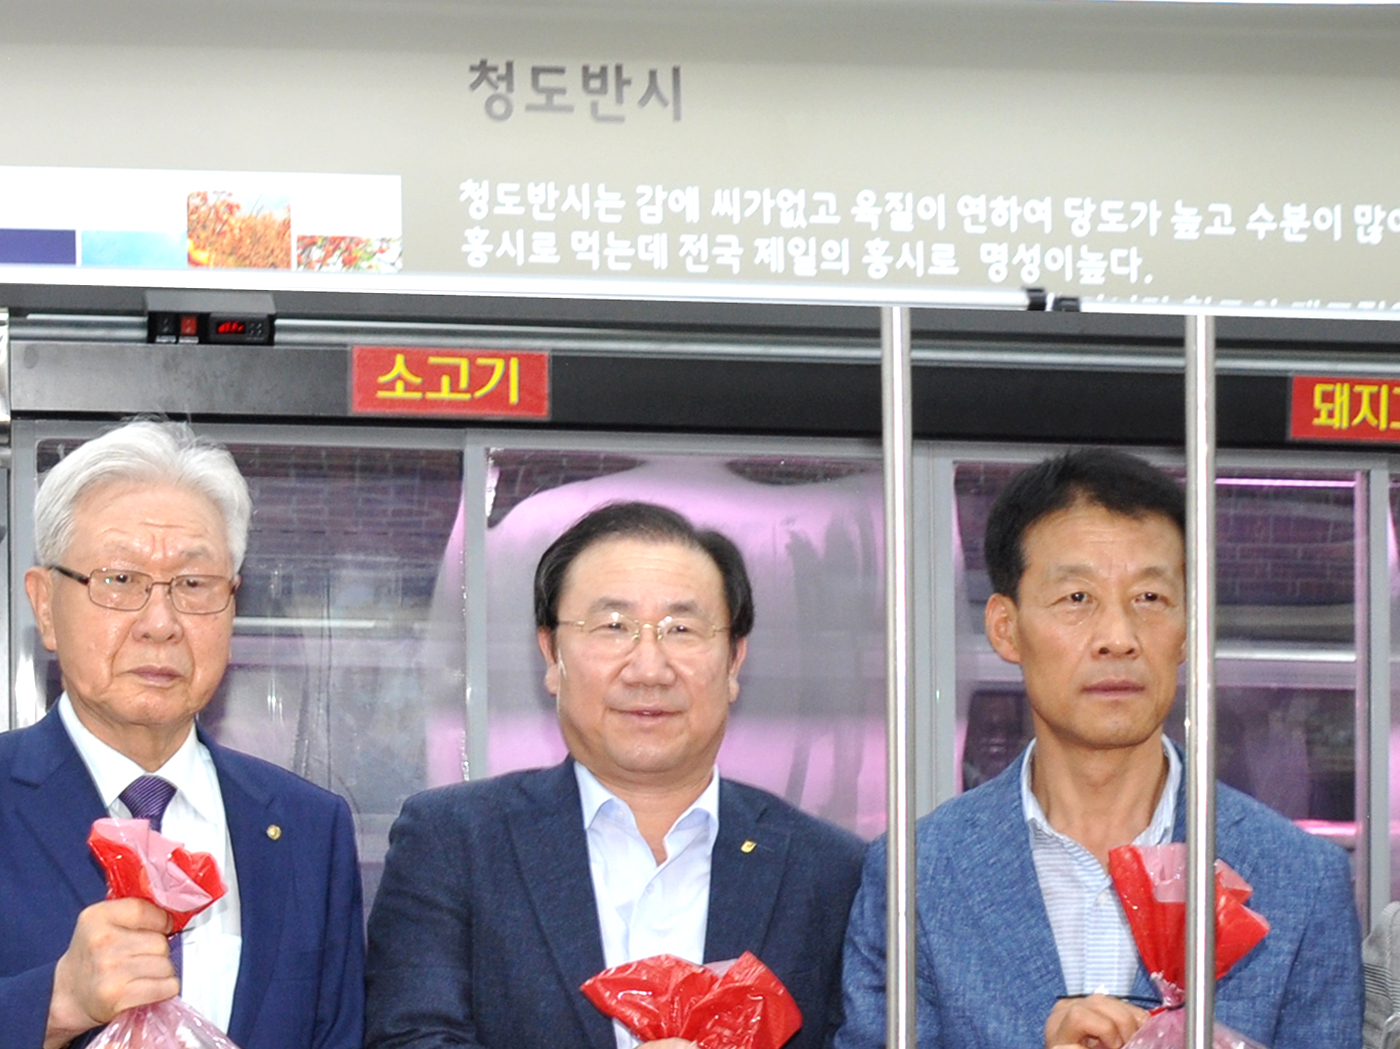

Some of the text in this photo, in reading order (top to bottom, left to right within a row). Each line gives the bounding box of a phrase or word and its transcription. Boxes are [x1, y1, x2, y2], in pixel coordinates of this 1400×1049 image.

[467, 58, 684, 124] 청도반시
[460, 179, 625, 223] 청도반시는
[636, 185, 699, 224] 감에
[711, 188, 841, 228] 씨가없고
[957, 195, 1051, 233] 연하여
[1064, 197, 1162, 237] 당도가
[1171, 200, 1236, 239] 높고
[1246, 203, 1341, 242] 수분이
[462, 226, 1152, 284] 홍시로 먹는데 전국 제일의 홍시로 명성이높다.
[375, 353, 522, 406] 소고기
[1312, 381, 1400, 431] 돼지
